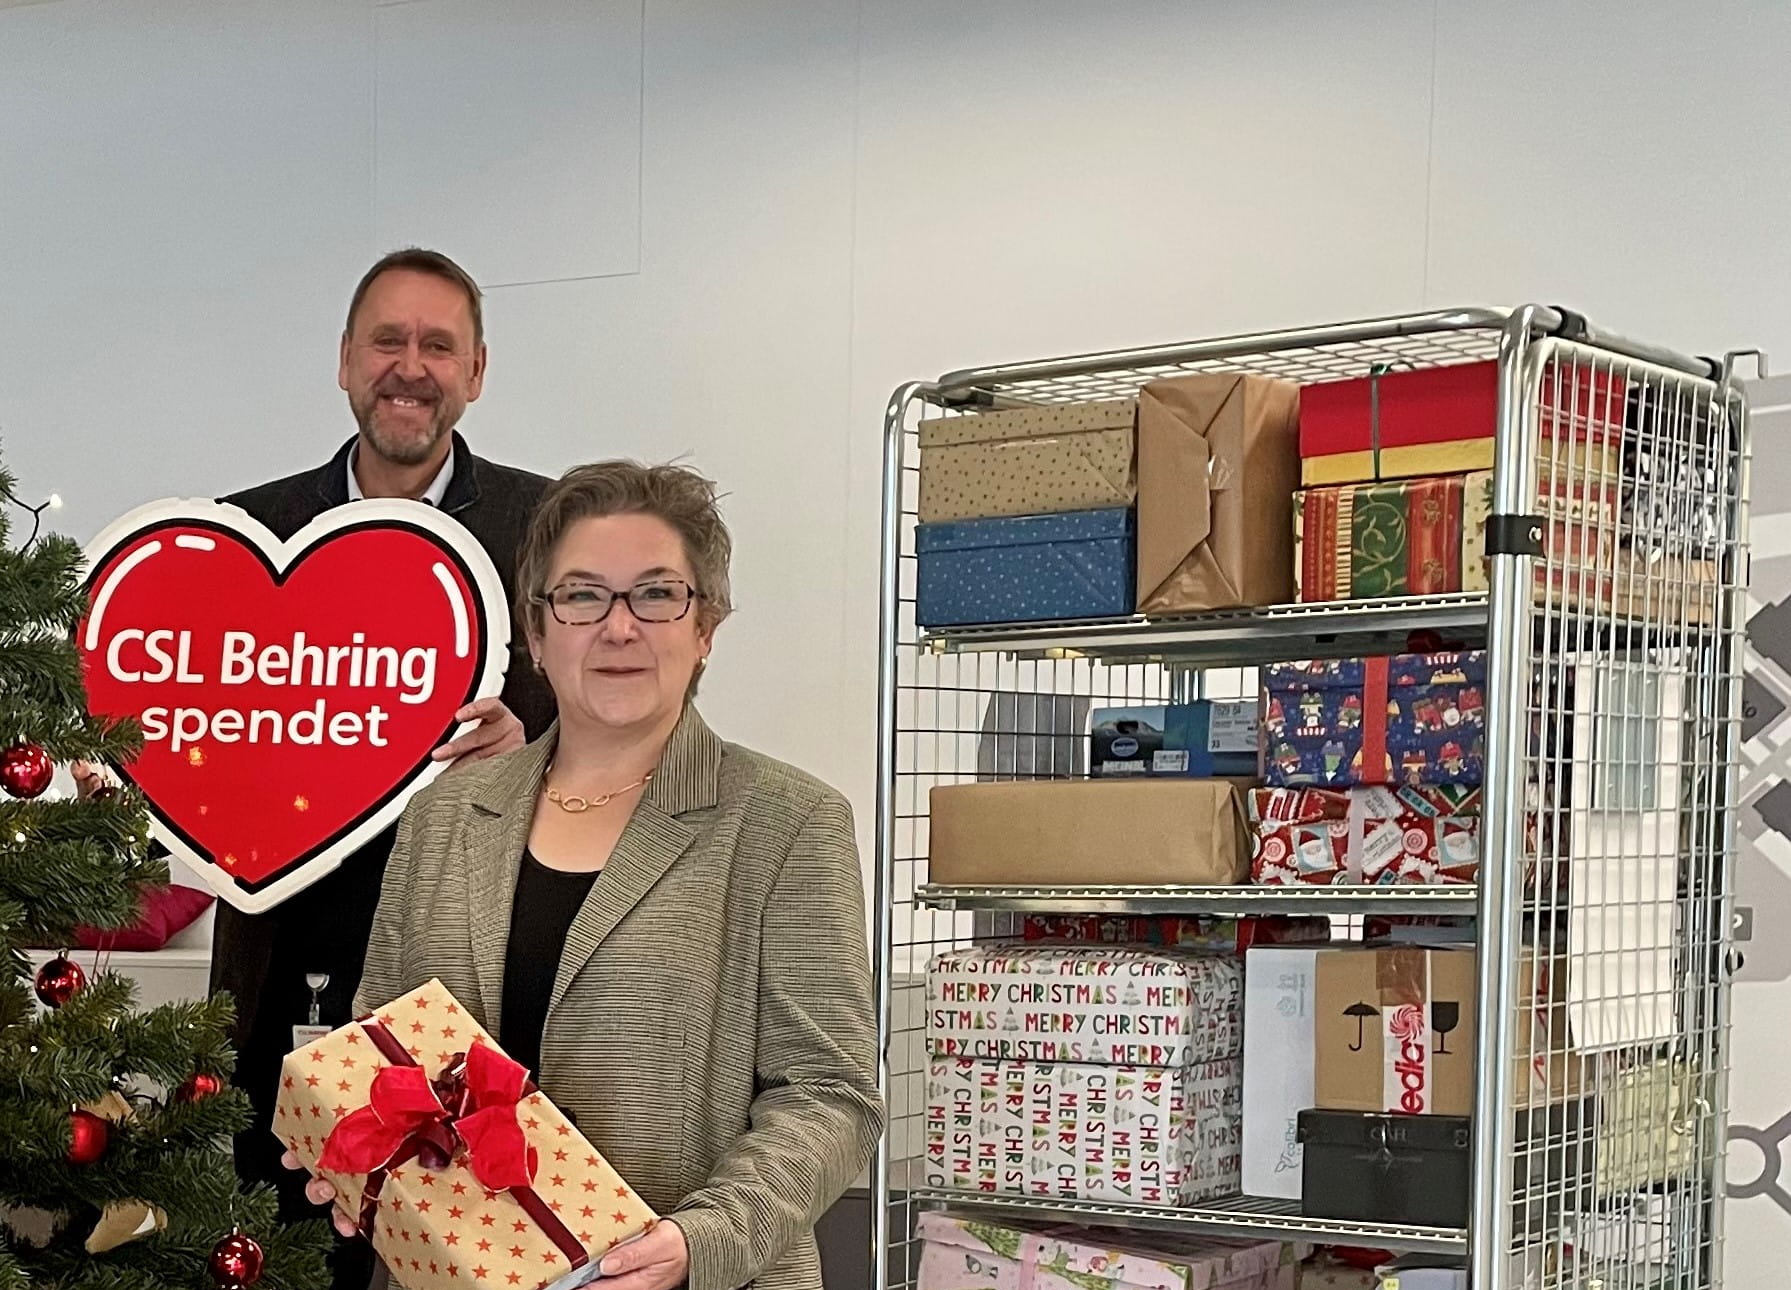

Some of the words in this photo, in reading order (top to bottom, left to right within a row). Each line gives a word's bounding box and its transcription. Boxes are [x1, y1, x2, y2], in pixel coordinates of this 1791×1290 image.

[106, 628, 205, 683] CSL
[220, 631, 438, 704] Behring
[140, 698, 389, 753] spendet
[942, 983, 1002, 1002] MERRY
[1008, 984, 1117, 1005] CHRISTMAS
[1060, 960, 1124, 976] MERRY
[975, 1039, 1083, 1062] CHRISTMAS
[1112, 1044, 1176, 1066] MERRY
[1025, 1013, 1087, 1034] MERRY
[928, 1106, 945, 1168] MERRY
[1058, 1093, 1077, 1158] MERRY
[1085, 1074, 1106, 1190] CHRISTMAS
[1112, 1131, 1131, 1197] MERRY
